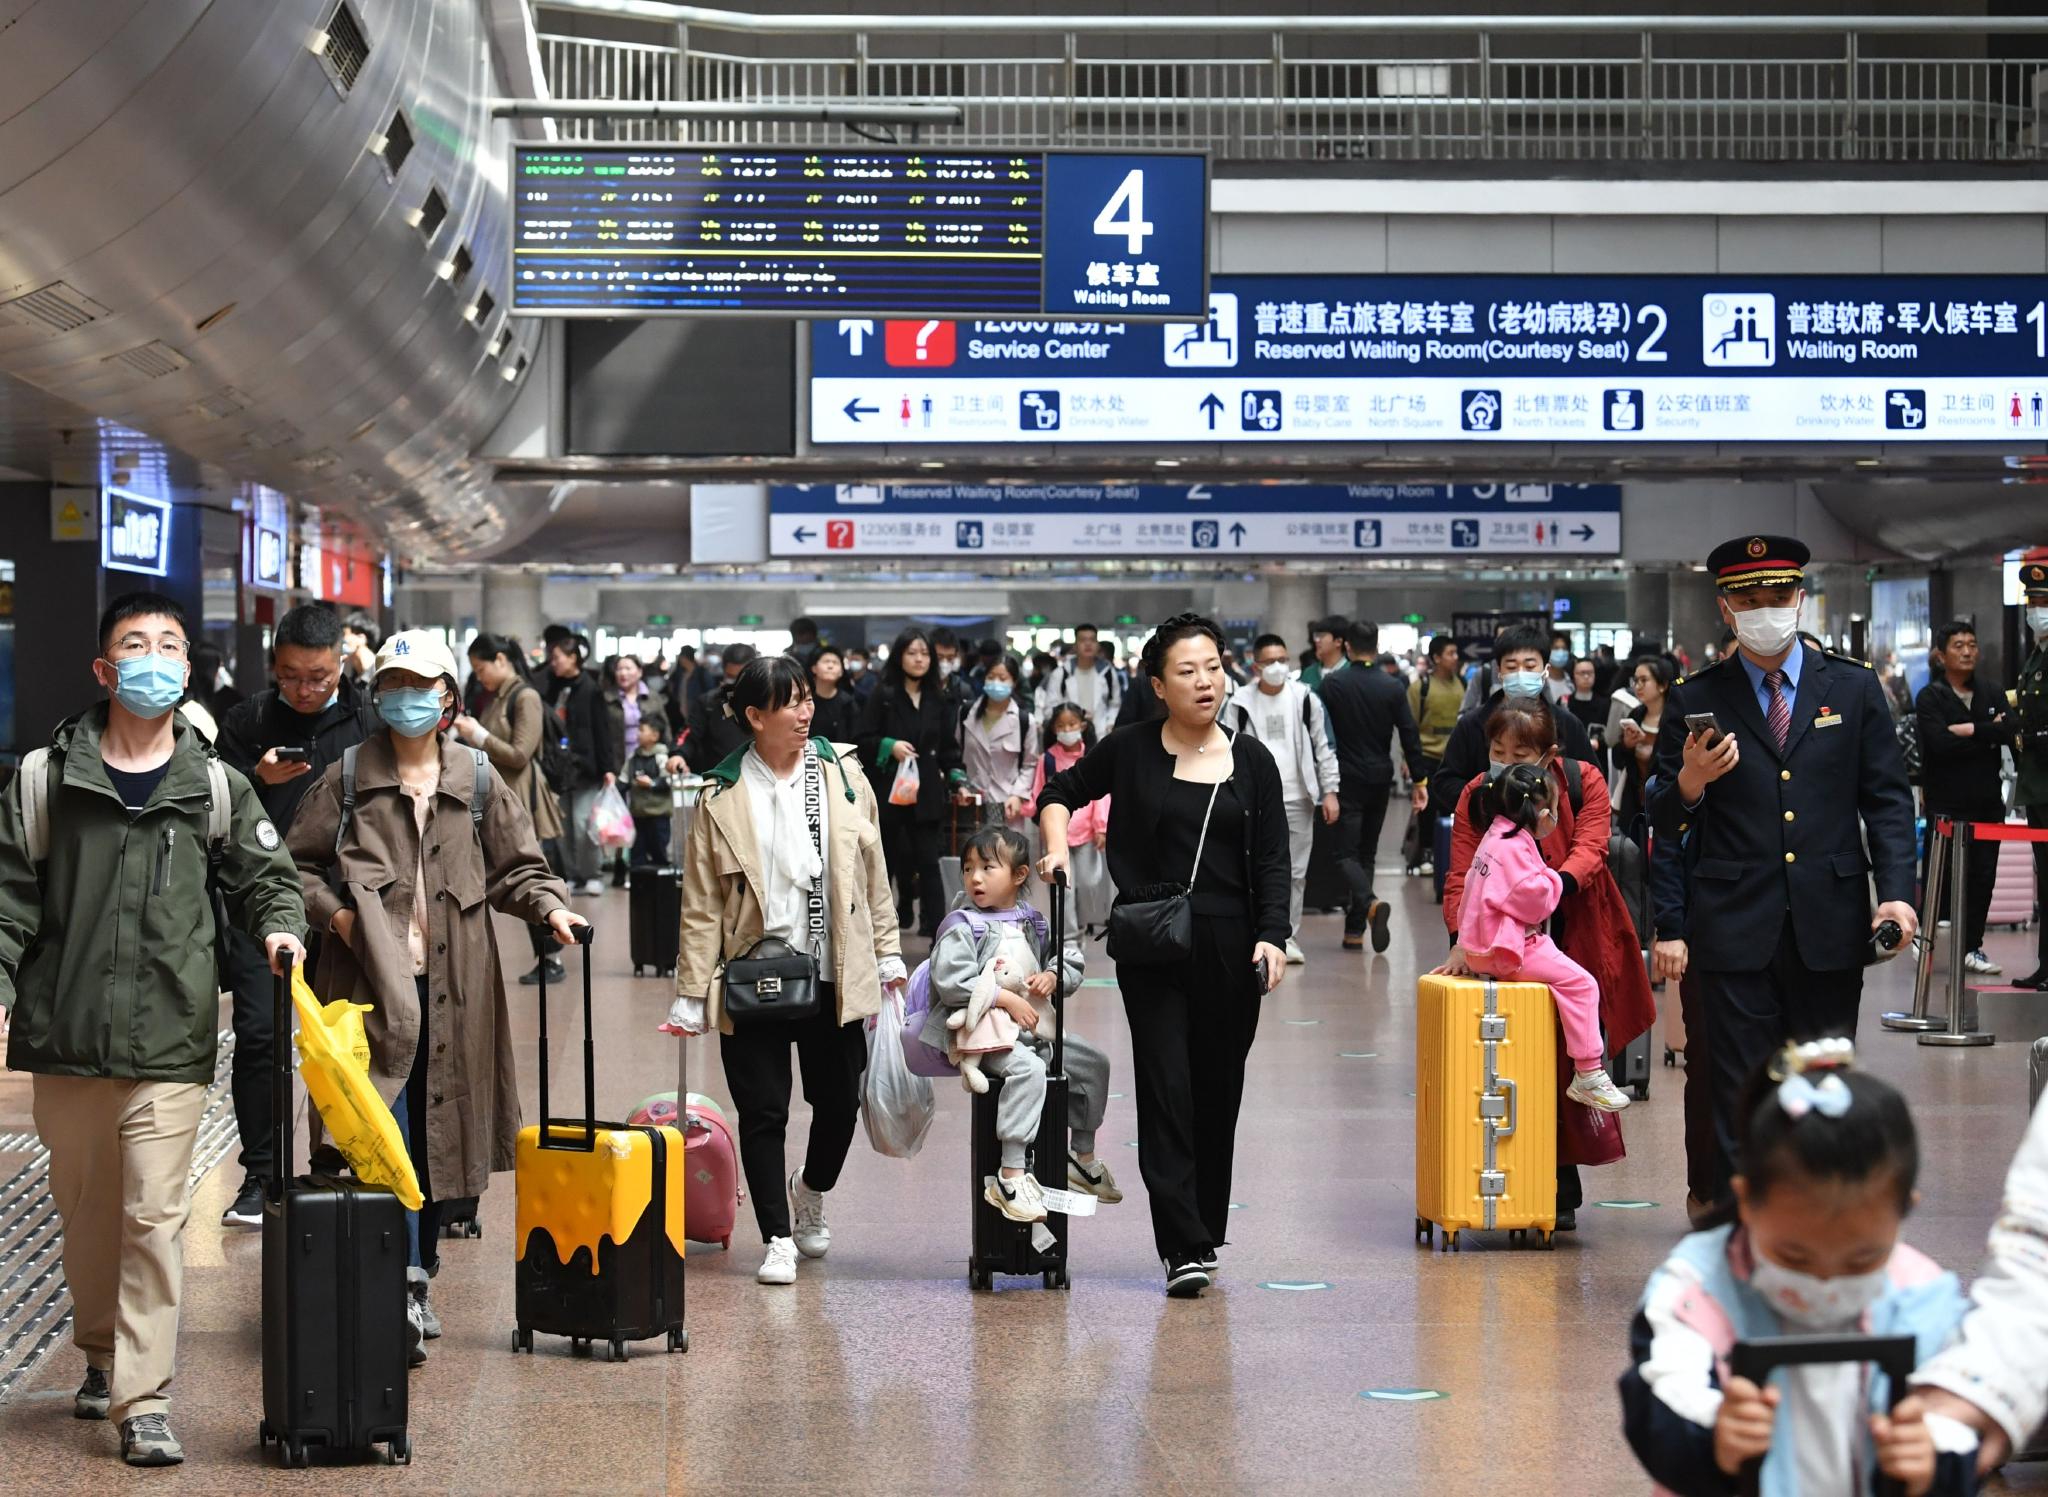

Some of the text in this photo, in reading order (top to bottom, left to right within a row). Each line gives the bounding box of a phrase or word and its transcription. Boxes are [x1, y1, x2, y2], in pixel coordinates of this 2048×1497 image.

[1093, 169, 1154, 255] 4
[1086, 261, 1160, 287] 候车室
[1073, 289, 1171, 308] Waiting Room
[1635, 304, 1669, 362] 2
[2026, 300, 2046, 358] 1
[968, 340, 1110, 358] Service Center
[1254, 339, 1631, 364] Reserved Waiting Room(Courtesy Seat)
[1786, 340, 1918, 364] Waiting Room
[950, 395, 1005, 413] 卫生间
[1069, 394, 1126, 413] 饮水处
[1293, 394, 1351, 413] 母婴室
[1368, 394, 1427, 413] 北广场
[1513, 394, 1590, 413] 北售票处
[1656, 394, 1752, 413] 公安值班室
[1819, 394, 1875, 413] 饮水处
[1941, 394, 1996, 413] 卫生间
[892, 486, 953, 499] Reserved
[955, 486, 1003, 501] Waiting
[1347, 484, 1394, 500] Waiting
[1397, 484, 1435, 498] Room
[394, 638, 411, 656] LA
[805, 754, 821, 826] SNOWOLD
